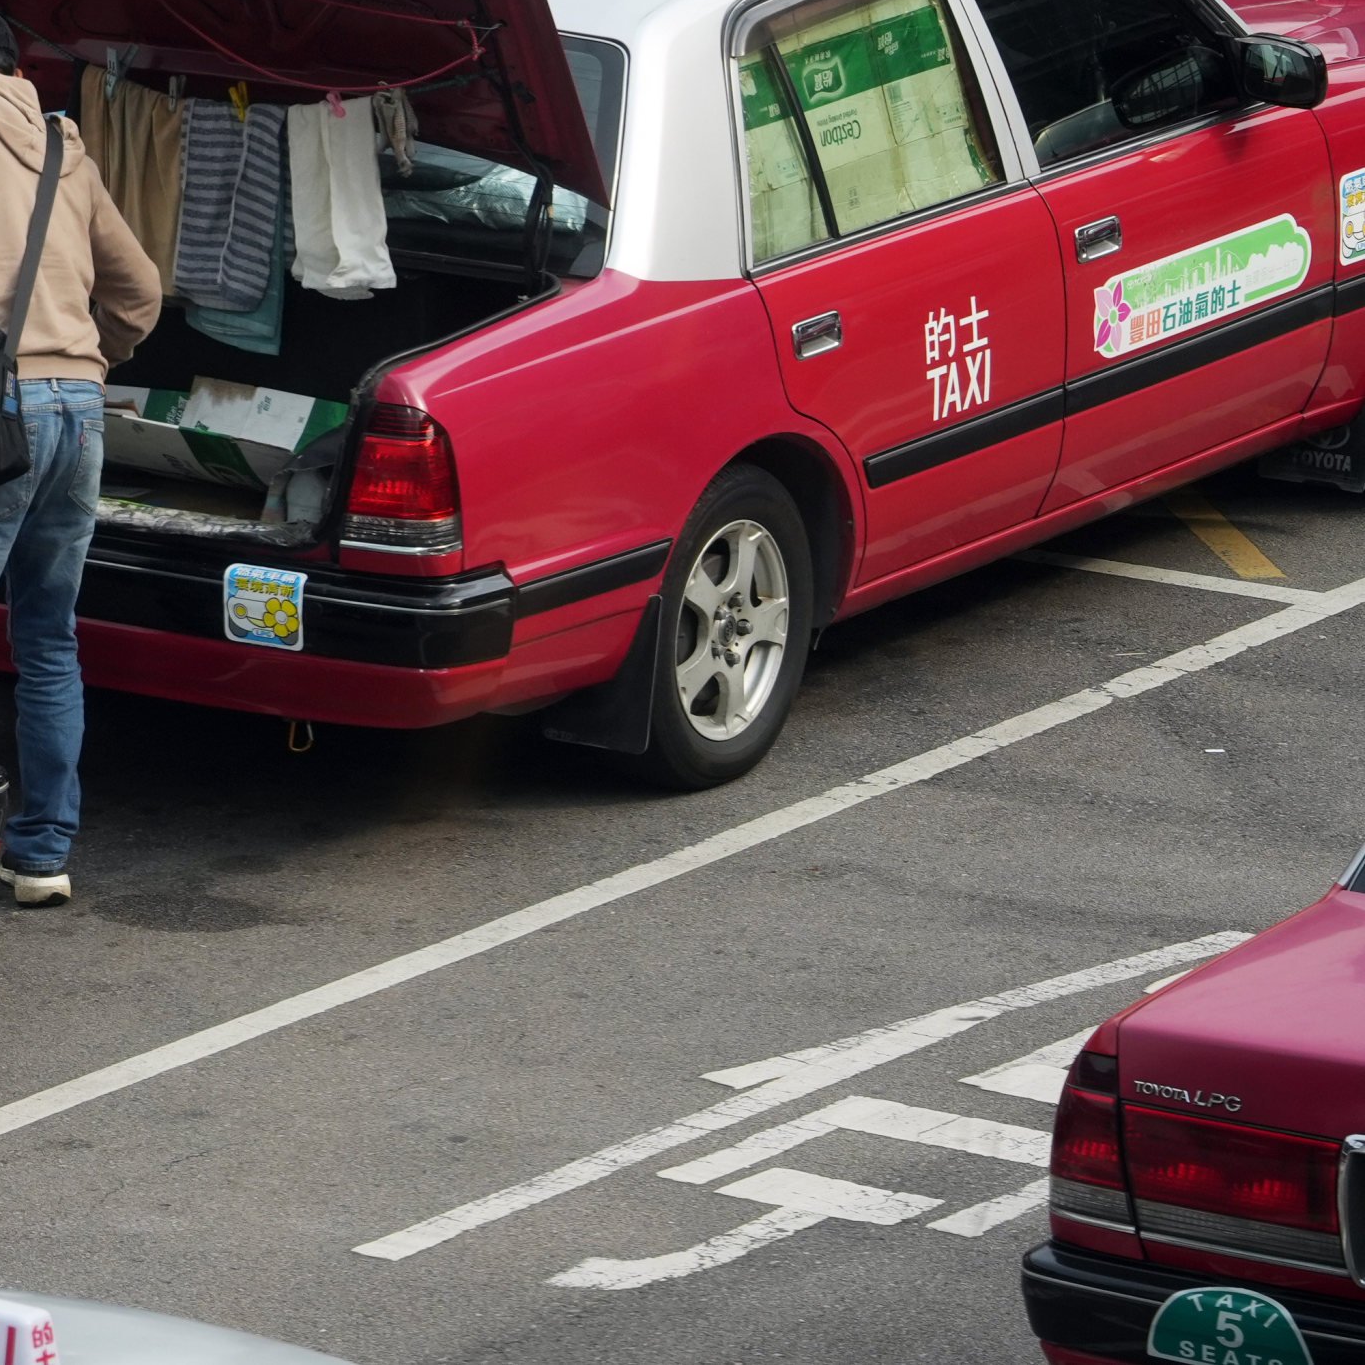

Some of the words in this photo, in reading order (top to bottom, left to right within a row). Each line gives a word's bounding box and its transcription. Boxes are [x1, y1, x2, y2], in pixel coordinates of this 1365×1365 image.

[924, 296, 990, 366] 的士
[1128, 279, 1242, 345] 豐田石油氣的士
[927, 349, 991, 421] TAXI
[1134, 1080, 1191, 1102] TOYOTA
[1192, 1091, 1243, 1113] LPG
[1187, 1293, 1279, 1328] TAXI
[1215, 1311, 1245, 1349] 5
